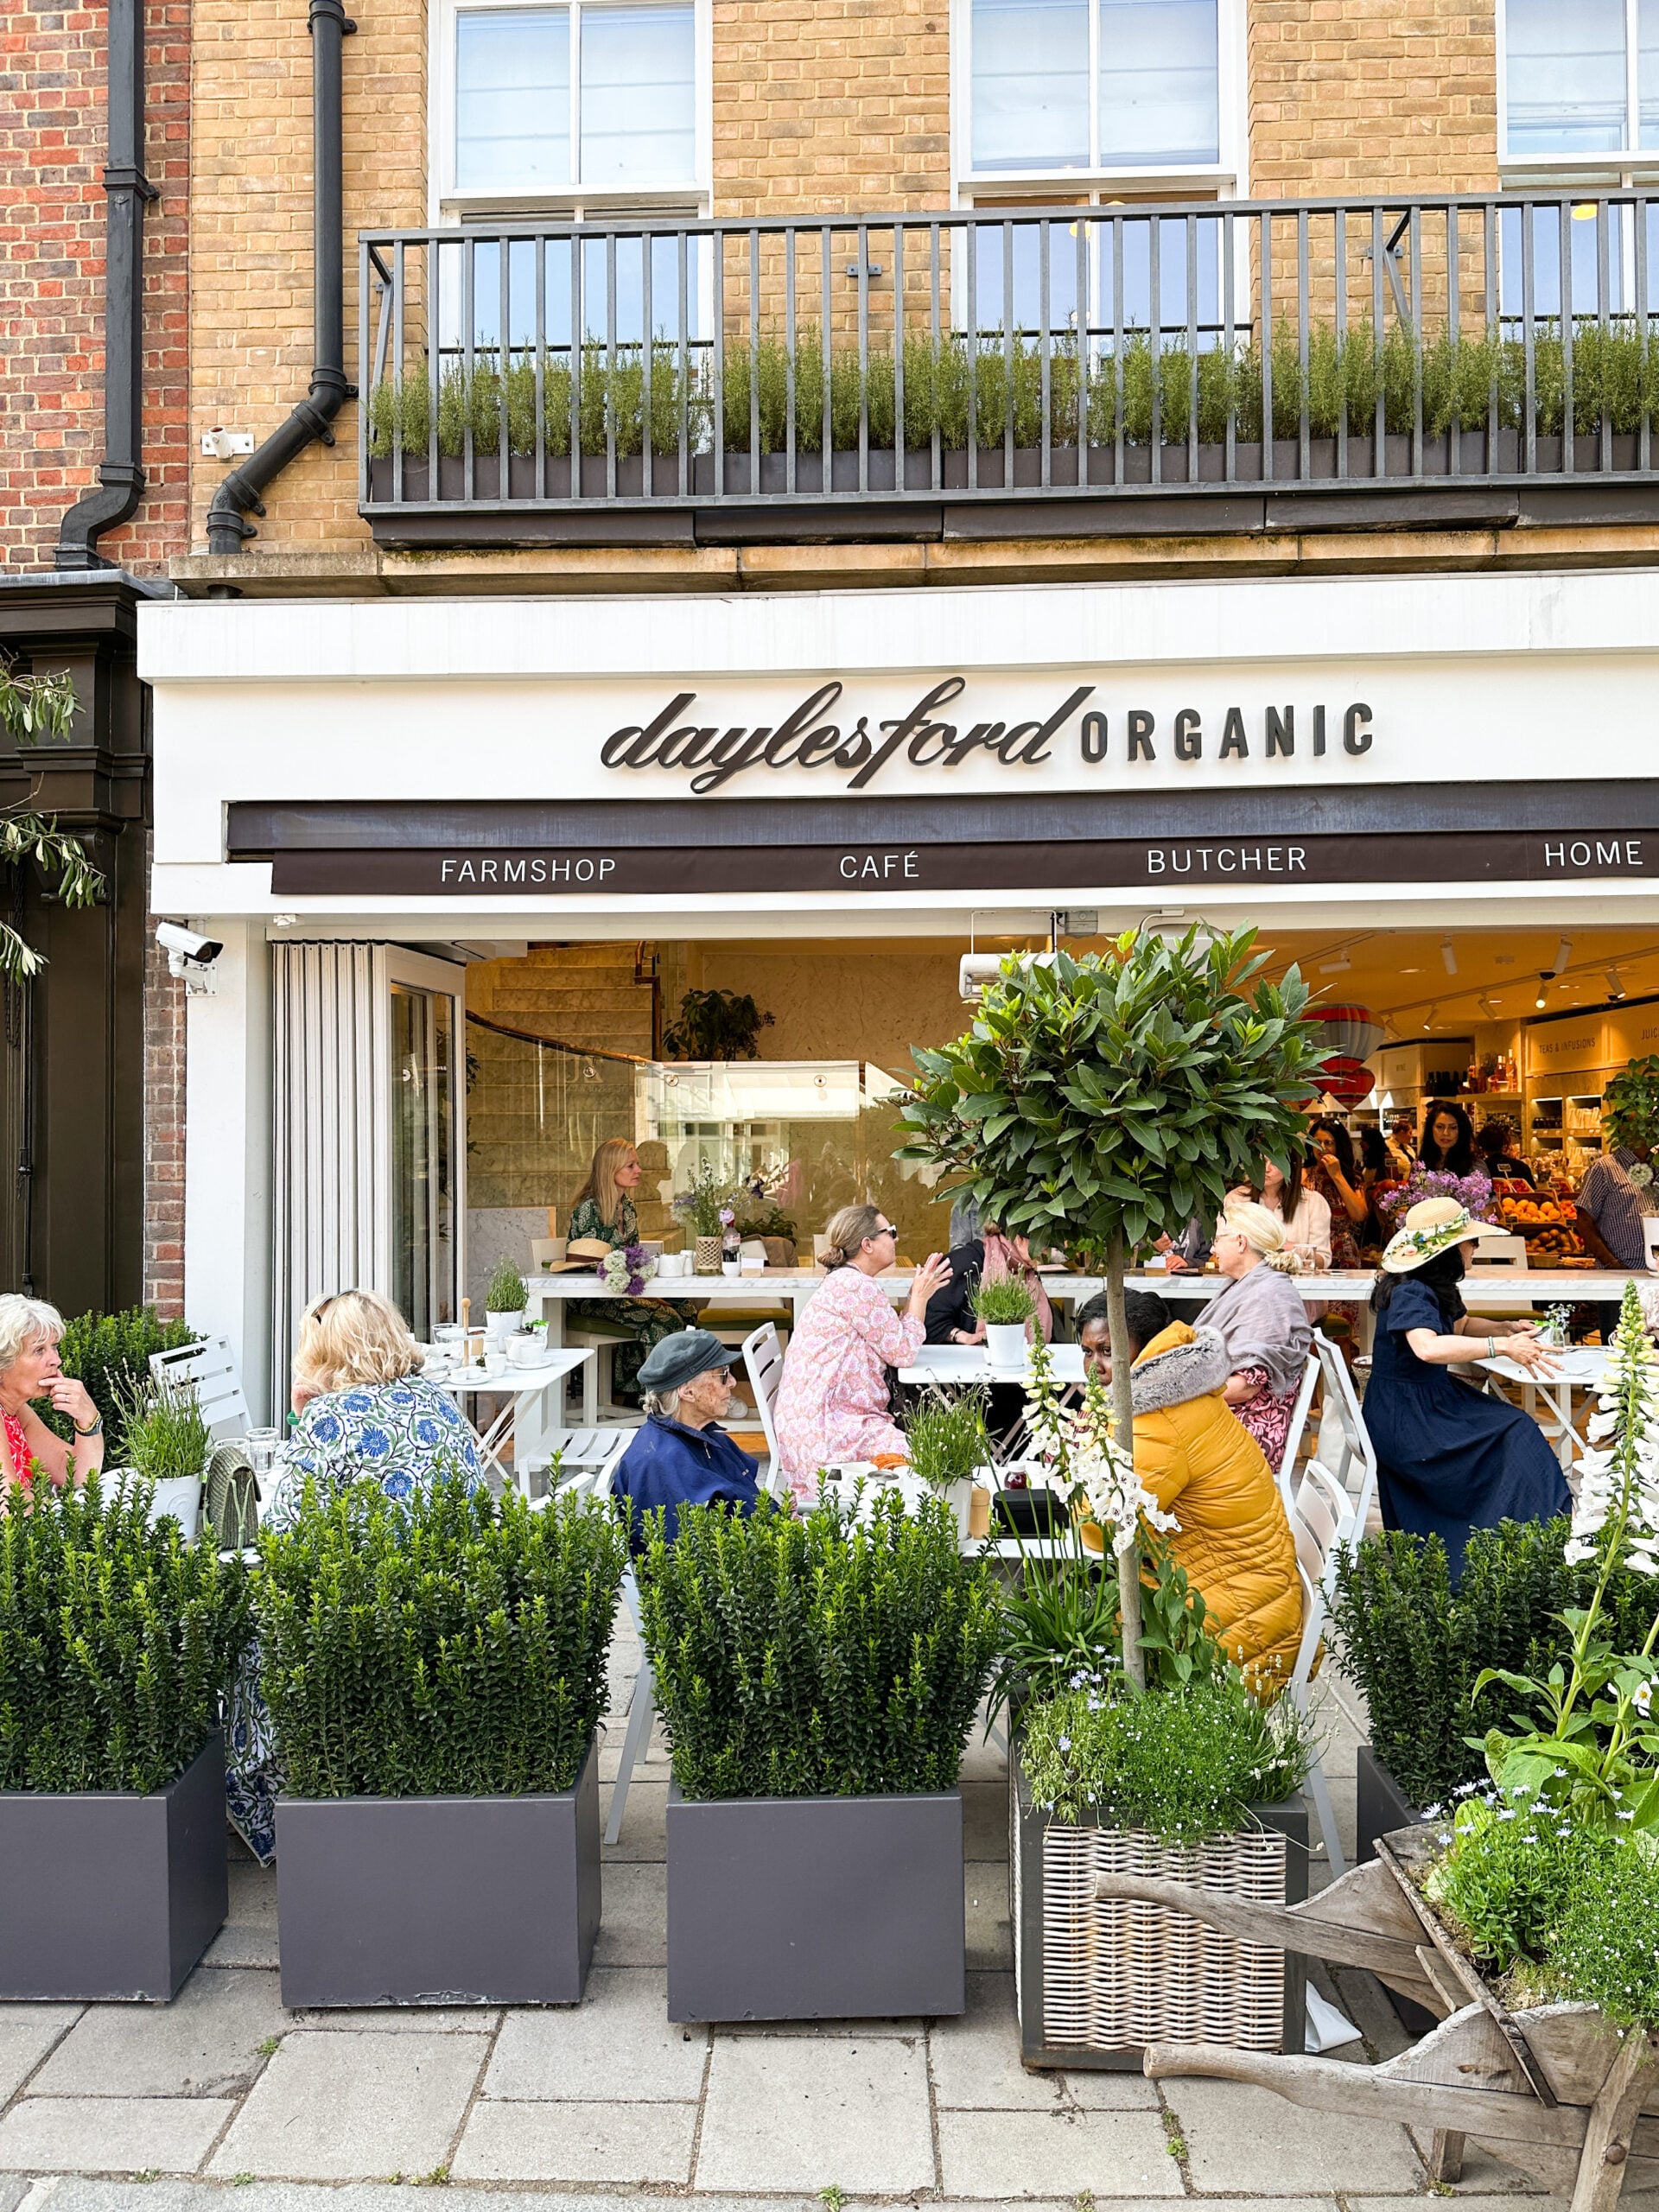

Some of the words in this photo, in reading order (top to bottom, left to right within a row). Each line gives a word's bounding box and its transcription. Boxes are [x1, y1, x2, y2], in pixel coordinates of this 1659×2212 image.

[601, 677, 1096, 793] daylesford
[1081, 703, 1373, 762] ORGANIC
[840, 851, 919, 879] CAFÉ
[1147, 847, 1306, 874] BUTCHER
[1544, 841, 1643, 867] HOME
[442, 858, 616, 882] FARMSHOP
[1539, 1042, 1553, 1053] TEAS
[1561, 1037, 1596, 1051] INFUSIONS
[1641, 1027, 1659, 1039] JUIC
